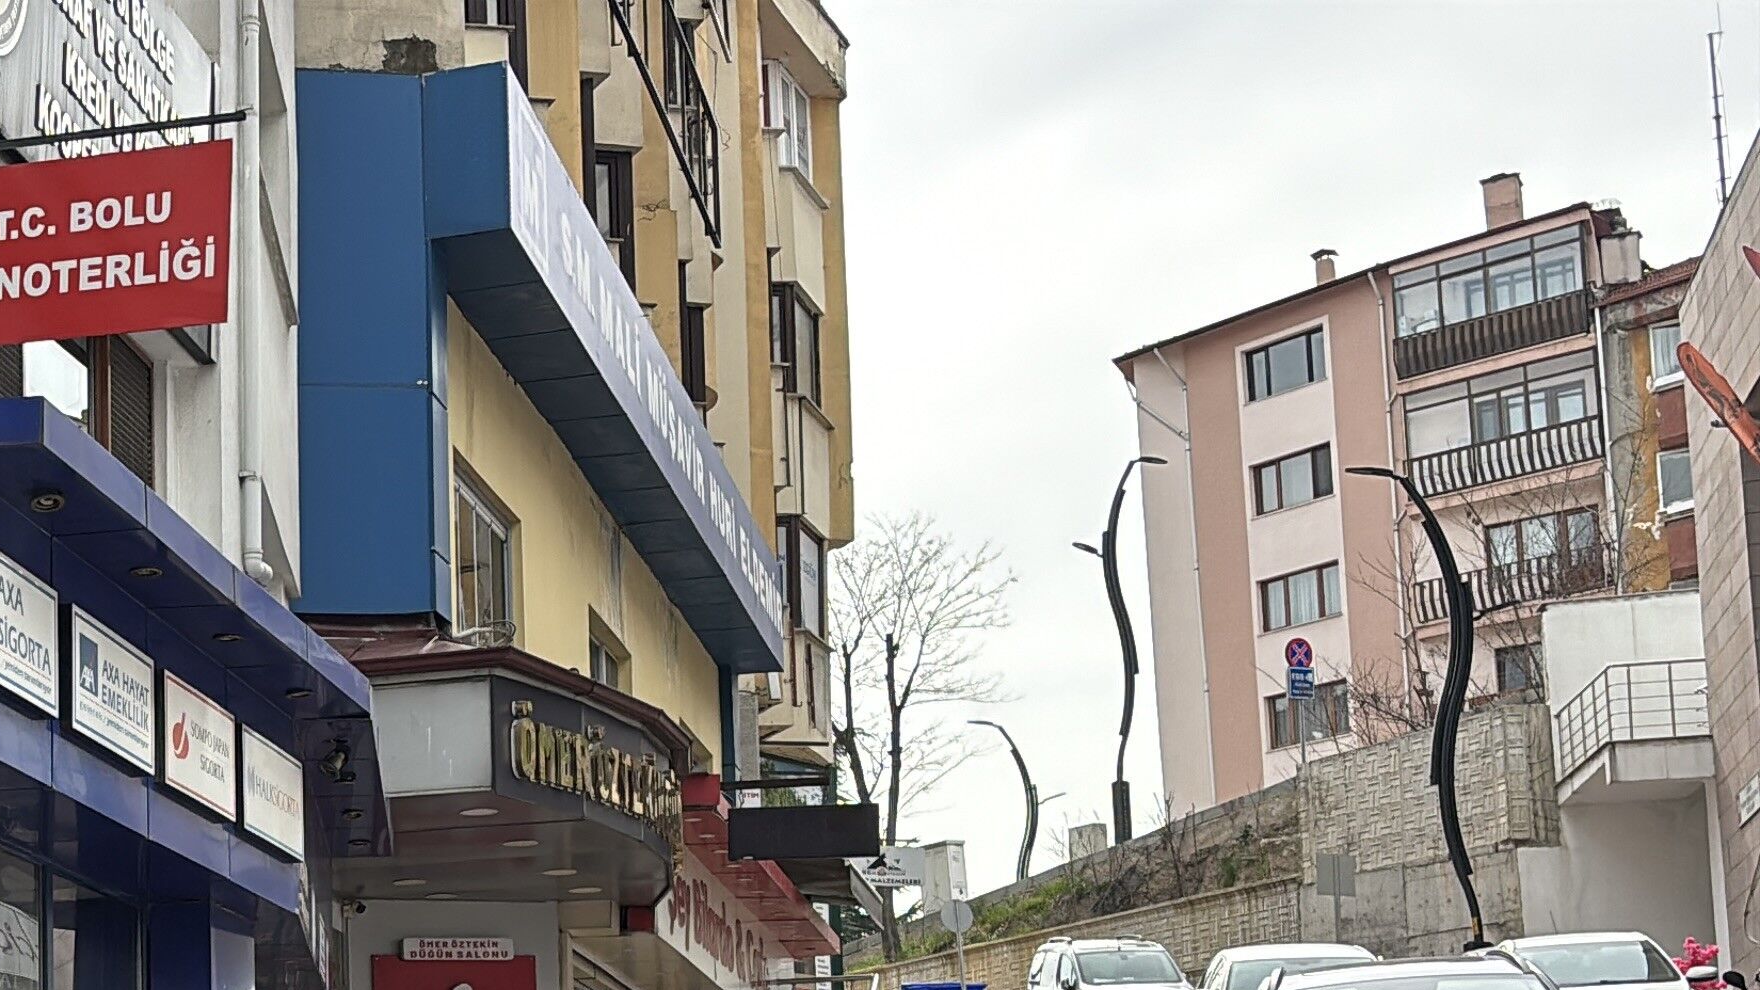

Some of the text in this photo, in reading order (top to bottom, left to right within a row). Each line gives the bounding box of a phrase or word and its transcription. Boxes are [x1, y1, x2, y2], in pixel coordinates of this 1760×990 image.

[95, 9, 116, 70] VE
[69, 191, 172, 233] BOLU
[102, 660, 149, 708] AXA HAYAT
[419, 939, 499, 949] ÖMER ÖZTEKİN
[457, 950, 508, 959] SALONU
